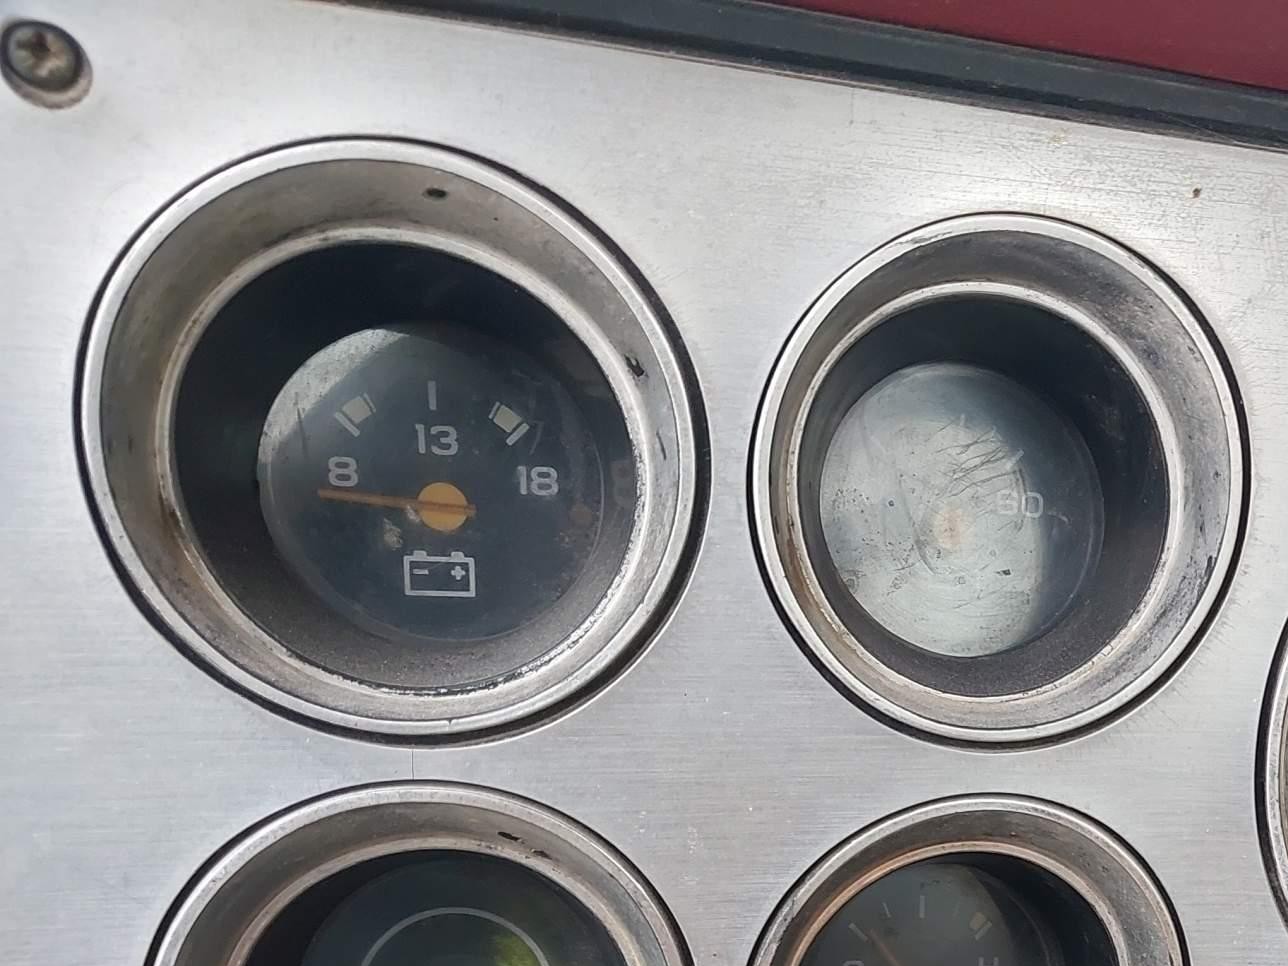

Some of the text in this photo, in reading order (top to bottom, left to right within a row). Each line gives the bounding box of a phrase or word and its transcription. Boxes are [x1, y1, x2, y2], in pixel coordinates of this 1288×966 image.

[415, 424, 458, 456] 13
[328, 456, 358, 487] 8
[516, 465, 559, 495] 18
